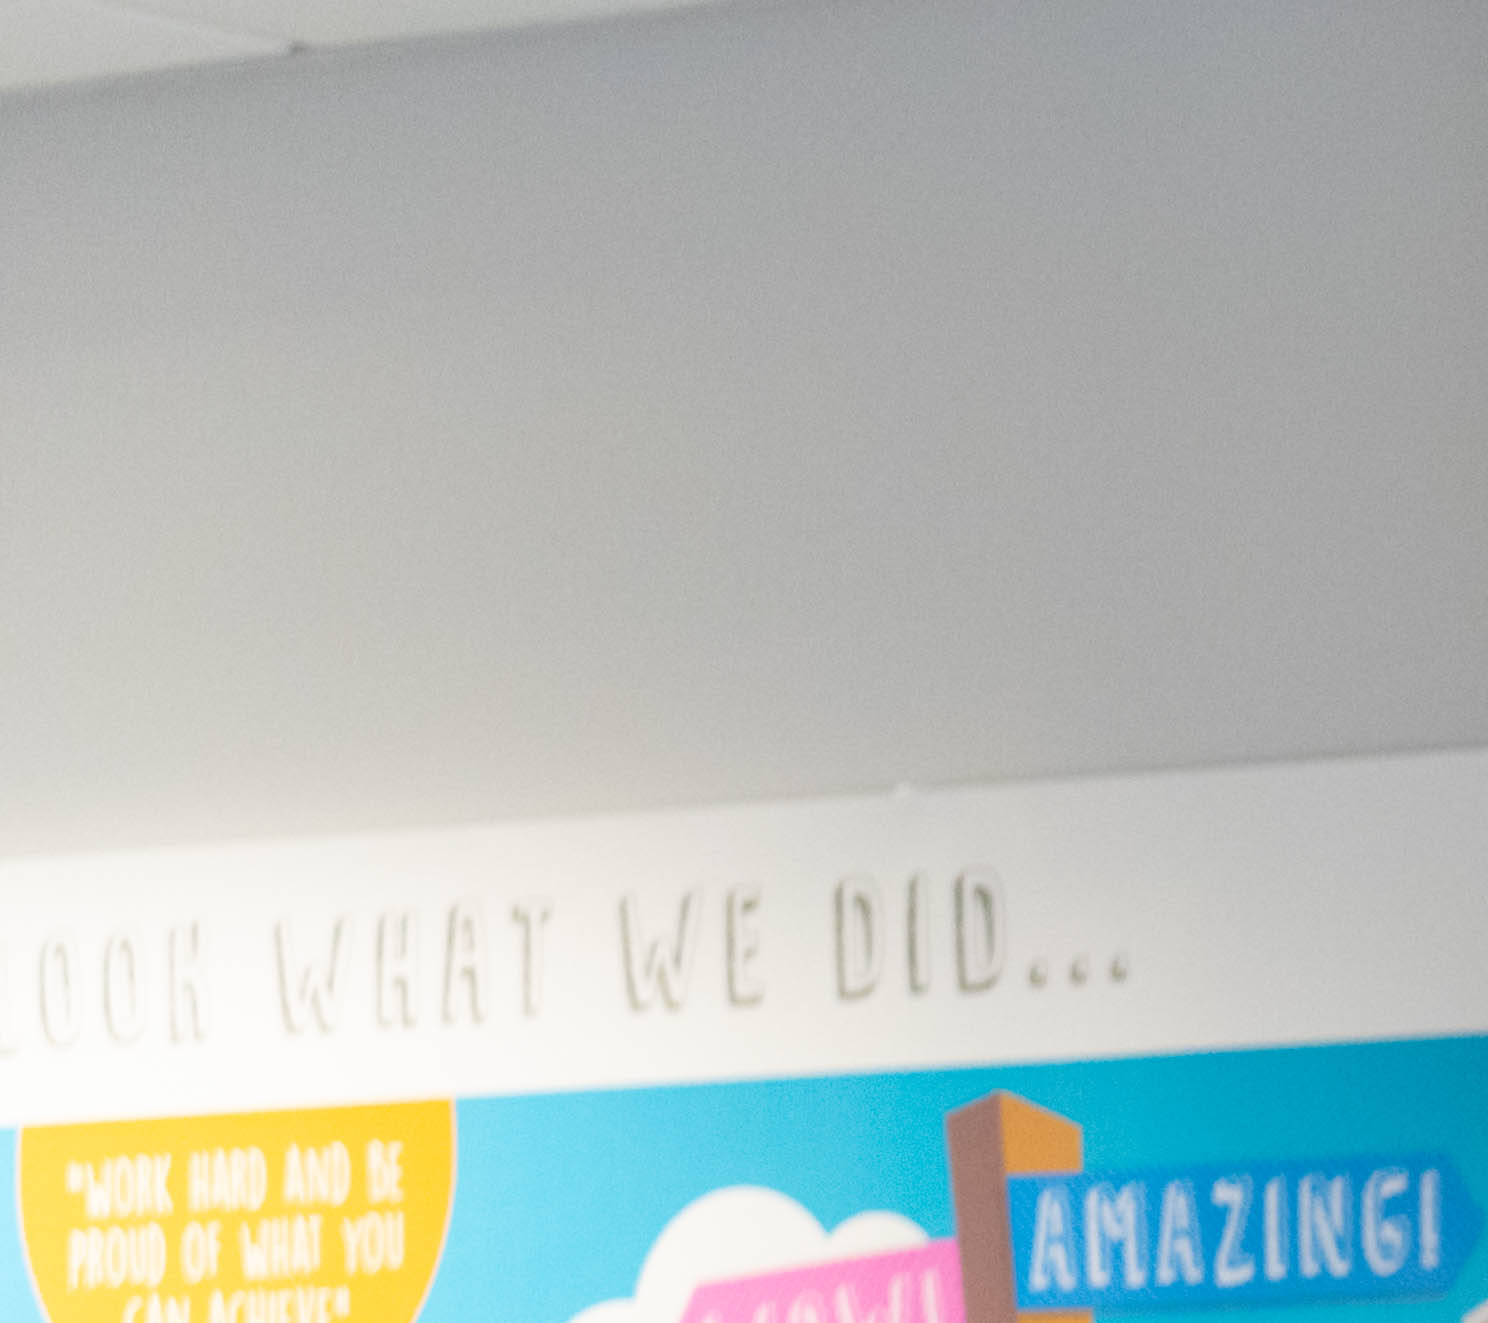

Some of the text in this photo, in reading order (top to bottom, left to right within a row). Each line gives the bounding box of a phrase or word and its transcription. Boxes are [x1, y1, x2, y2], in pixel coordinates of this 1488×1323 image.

[0, 916, 212, 1056] OOK
[272, 895, 554, 1038] WHAT
[618, 884, 768, 1013] WE
[186, 1144, 268, 1214] HARD
[282, 1140, 352, 1209] AND
[364, 1137, 405, 1205] BE
[65, 1208, 406, 1293] PROUD OF WHAT YOU
[1027, 1165, 1443, 1293] AMAZING!
